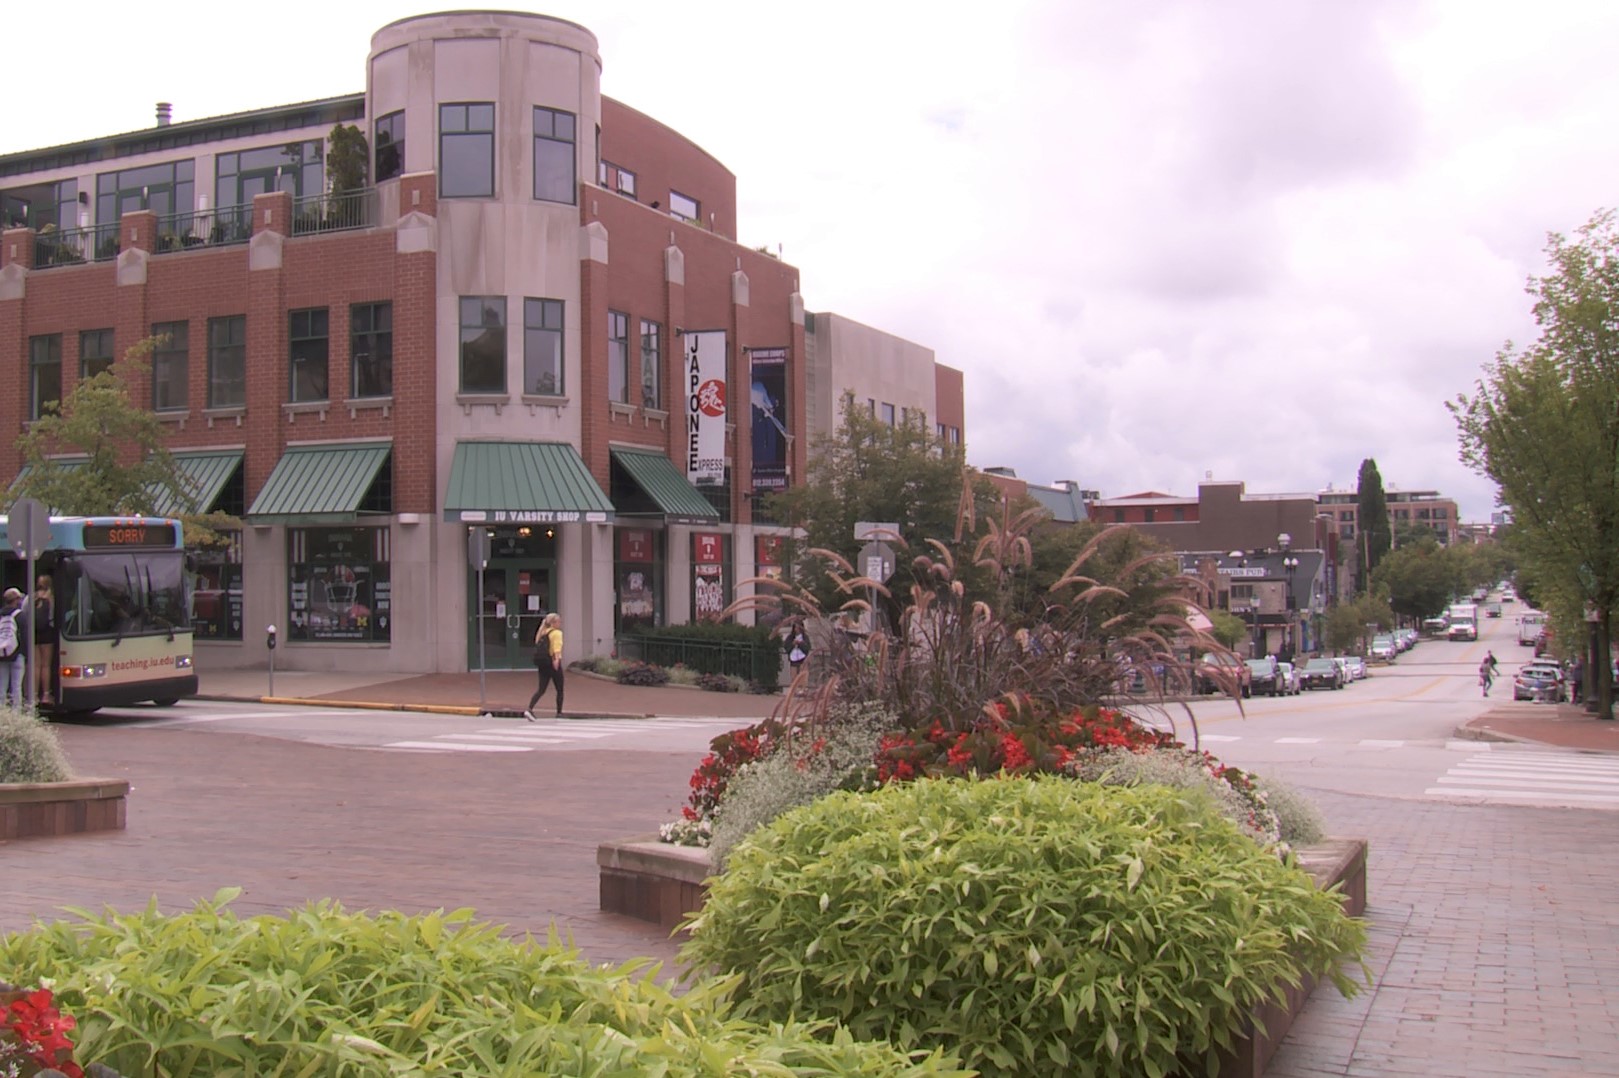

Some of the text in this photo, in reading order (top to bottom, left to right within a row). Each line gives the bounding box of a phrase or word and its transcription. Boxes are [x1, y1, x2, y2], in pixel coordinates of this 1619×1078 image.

[690, 335, 699, 471] JAPONEE
[495, 511, 506, 521] IU
[510, 511, 554, 521] VARSITY
[557, 512, 580, 522] SHOP
[109, 530, 145, 543] SORRY
[111, 656, 174, 671] teaching.iu.edu
